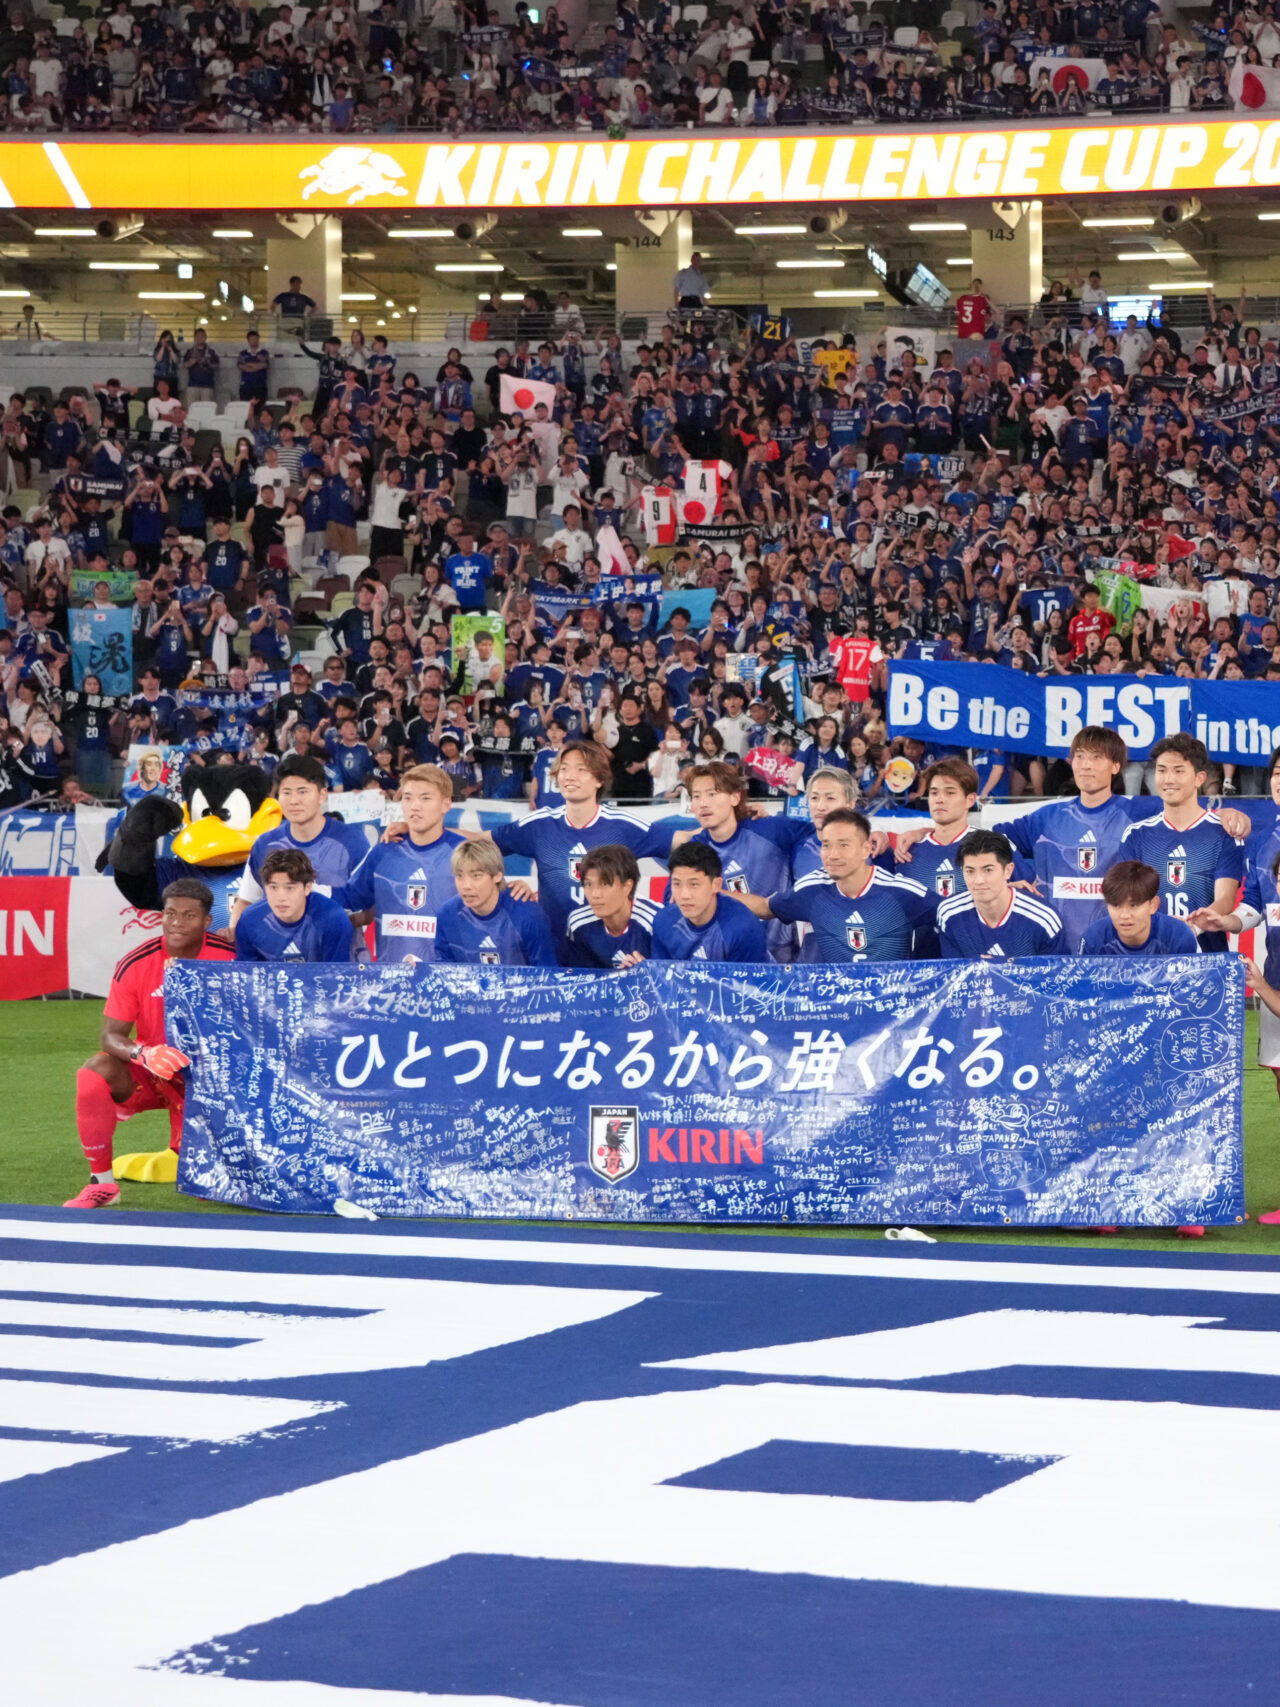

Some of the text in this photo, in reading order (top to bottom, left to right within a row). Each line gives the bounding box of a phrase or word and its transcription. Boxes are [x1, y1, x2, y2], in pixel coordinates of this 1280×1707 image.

[416, 143, 630, 206] KIRIN
[637, 132, 1051, 203] CHALLENGE
[1060, 125, 1208, 192] CUP
[632, 235, 662, 248] 144
[986, 228, 1015, 242] 143
[962, 305, 973, 323] 3
[763, 321, 782, 340] 21
[937, 461, 965, 473] KUBO
[86, 481, 124, 497] SAMURAI BLUE
[699, 472, 707, 493] 4
[653, 500, 660, 522] 9
[895, 511, 920, 527] 谷口
[88, 528, 101, 538] 20
[686, 527, 728, 538] SAMURAI
[215, 555, 228, 566] 20
[489, 617, 502, 634] 5
[170, 640, 178, 652] 9
[848, 649, 867, 672] 17
[889, 673, 959, 731] Be
[968, 697, 1030, 740] the
[1045, 683, 1190, 748] BEST
[1196, 713, 1230, 753] in
[85, 728, 99, 739] 20
[1165, 891, 1190, 917] 16
[406, 919, 436, 933] KIRI
[1199, 1023, 1214, 1063] JAPAN
[334, 1026, 1039, 1091] ひとつになるから強くなる。
[601, 1108, 629, 1117] JAPAN
[1147, 1117, 1166, 1135] FOR
[1165, 1110, 1185, 1127] OUR
[649, 1127, 764, 1164] KIRIN
[894, 1133, 920, 1144] Japan's
[601, 1157, 626, 1170] JFA
